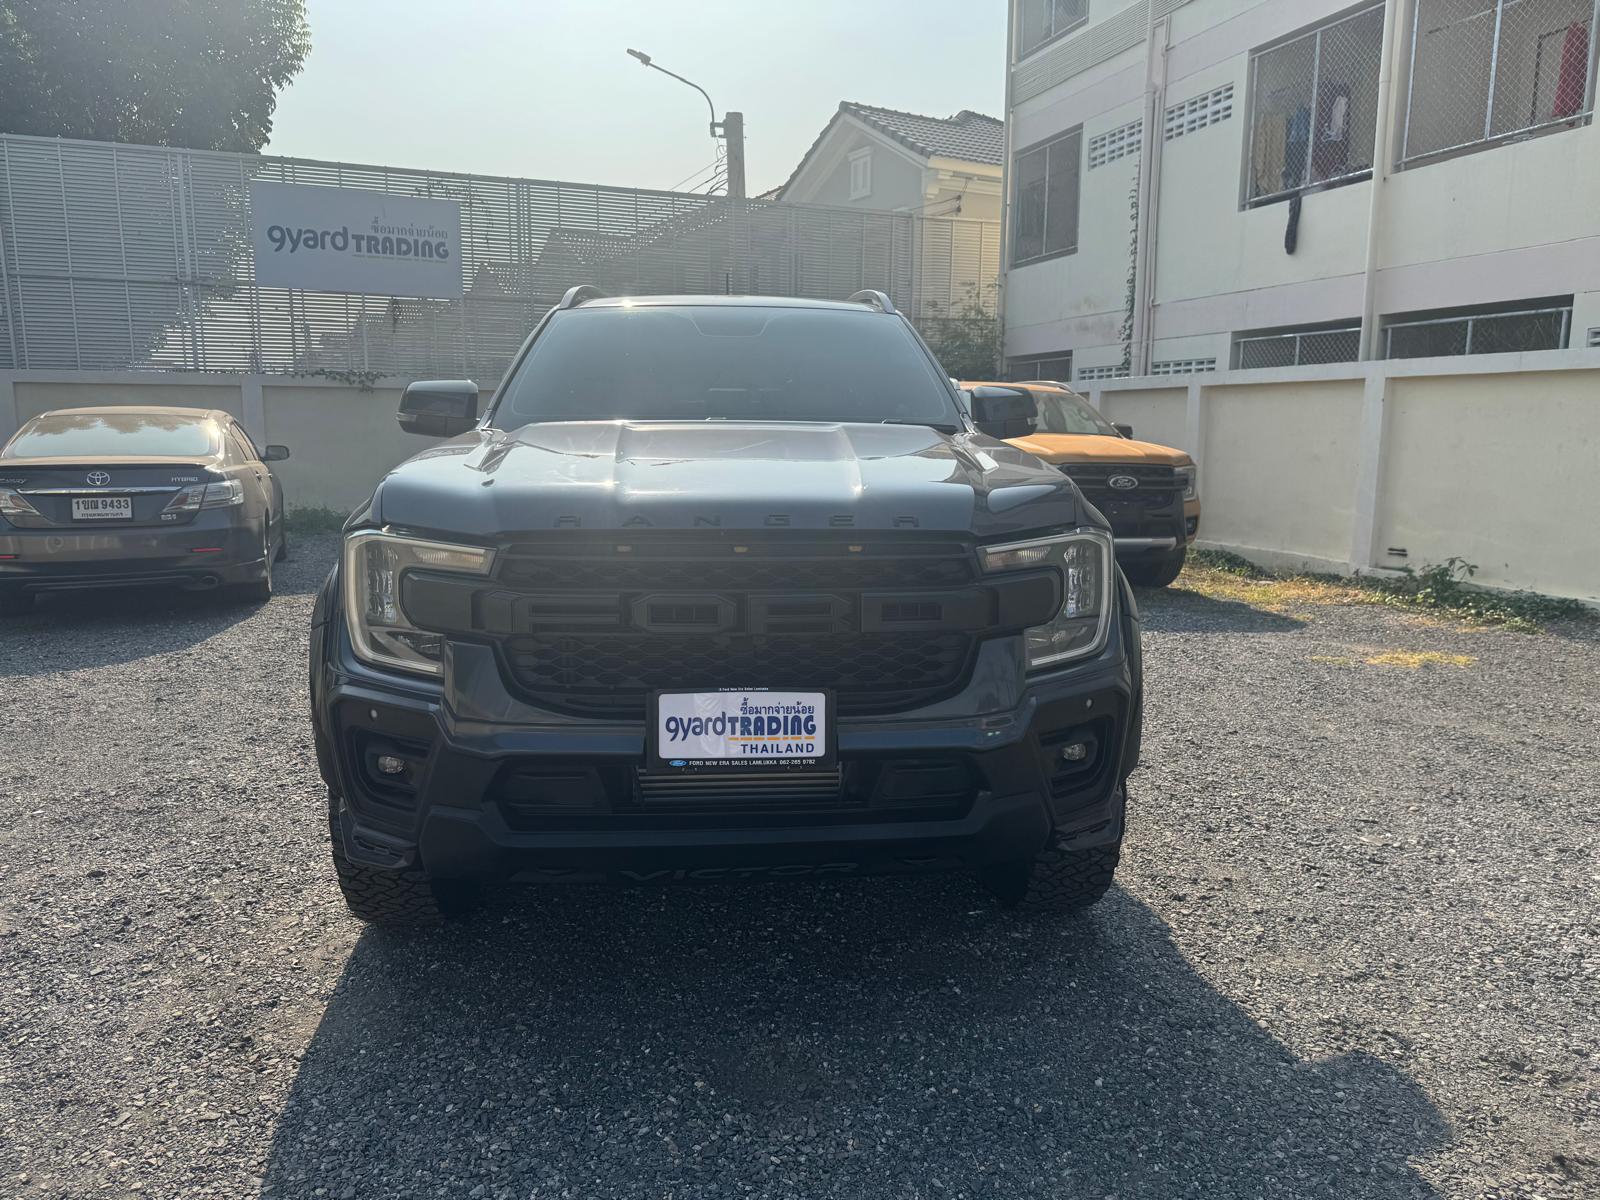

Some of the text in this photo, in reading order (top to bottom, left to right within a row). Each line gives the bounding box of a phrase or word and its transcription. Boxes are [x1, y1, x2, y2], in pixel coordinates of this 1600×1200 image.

[266, 225, 449, 259] 9yard TRADING
[101, 499, 130, 510] 9433
[554, 514, 921, 529] RANGER
[740, 697, 815, 715] ซื้อมากจ่ายน้อย
[665, 711, 817, 742] 9yard TRADING
[740, 743, 815, 754] THAILAND
